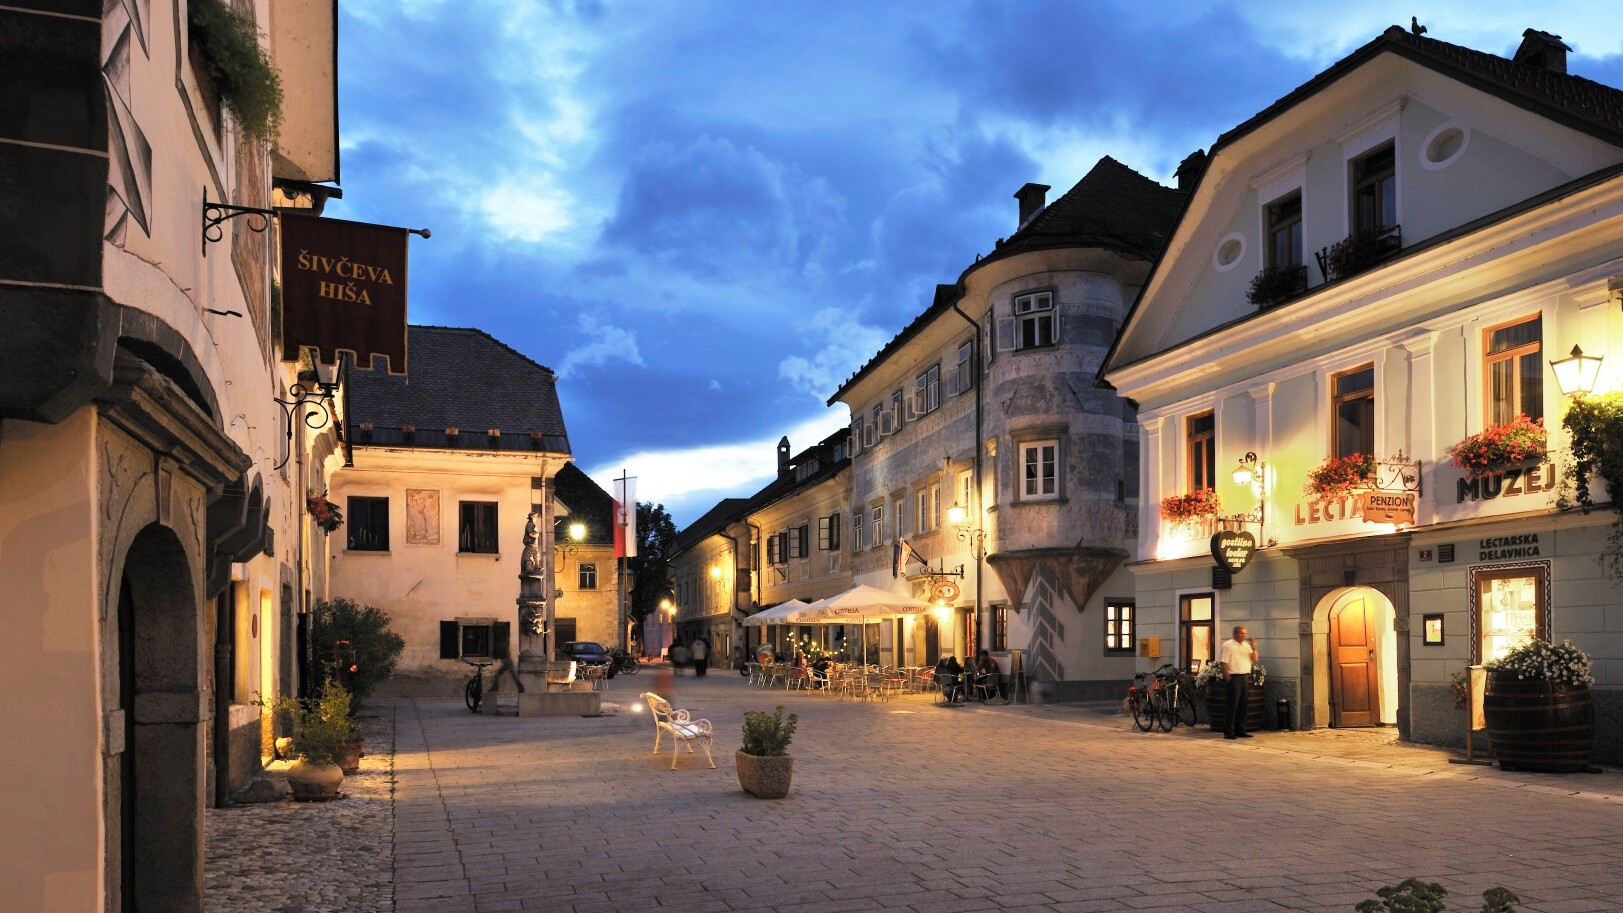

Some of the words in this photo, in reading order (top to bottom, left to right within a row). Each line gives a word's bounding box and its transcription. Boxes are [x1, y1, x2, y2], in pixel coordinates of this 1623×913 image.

[298, 248, 394, 286] ŠIVČEVA
[319, 281, 372, 305] HIŠA
[1457, 464, 1556, 504] MUZEJ
[1294, 494, 1365, 526] LECTA
[1370, 495, 1408, 507] PENZION
[1480, 533, 1539, 549] LECTARSKA
[1480, 546, 1540, 561] DELAVNICA
